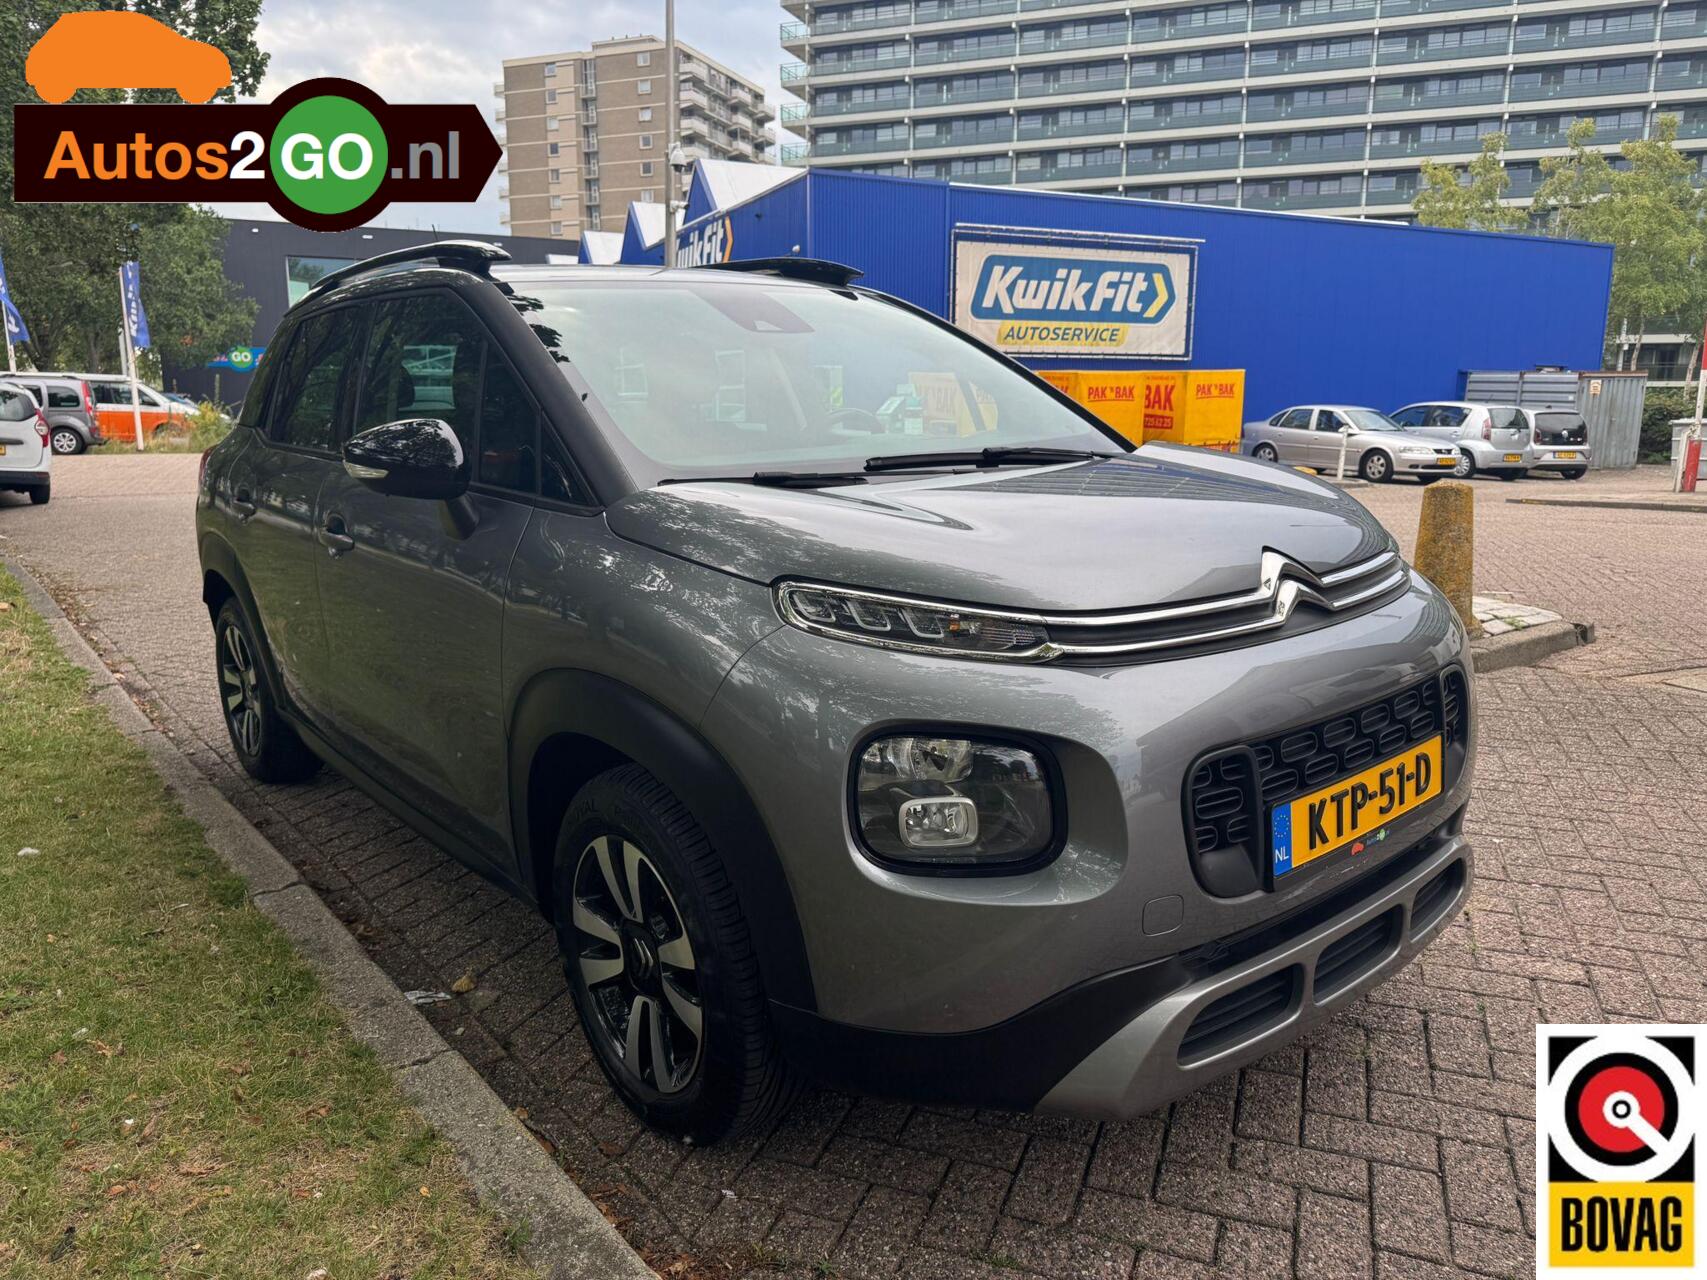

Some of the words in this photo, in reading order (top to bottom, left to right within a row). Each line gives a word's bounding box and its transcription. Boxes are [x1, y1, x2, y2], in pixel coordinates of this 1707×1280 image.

[1004, 326, 1121, 342] AUTOSERVICE
[1087, 386, 1107, 400] PAK
[1115, 385, 1135, 400] BAK
[1196, 383, 1213, 397] PAK
[1219, 382, 1236, 396] BAK
[1308, 752, 1432, 850] KTP-51-D
[1274, 846, 1290, 864] NL
